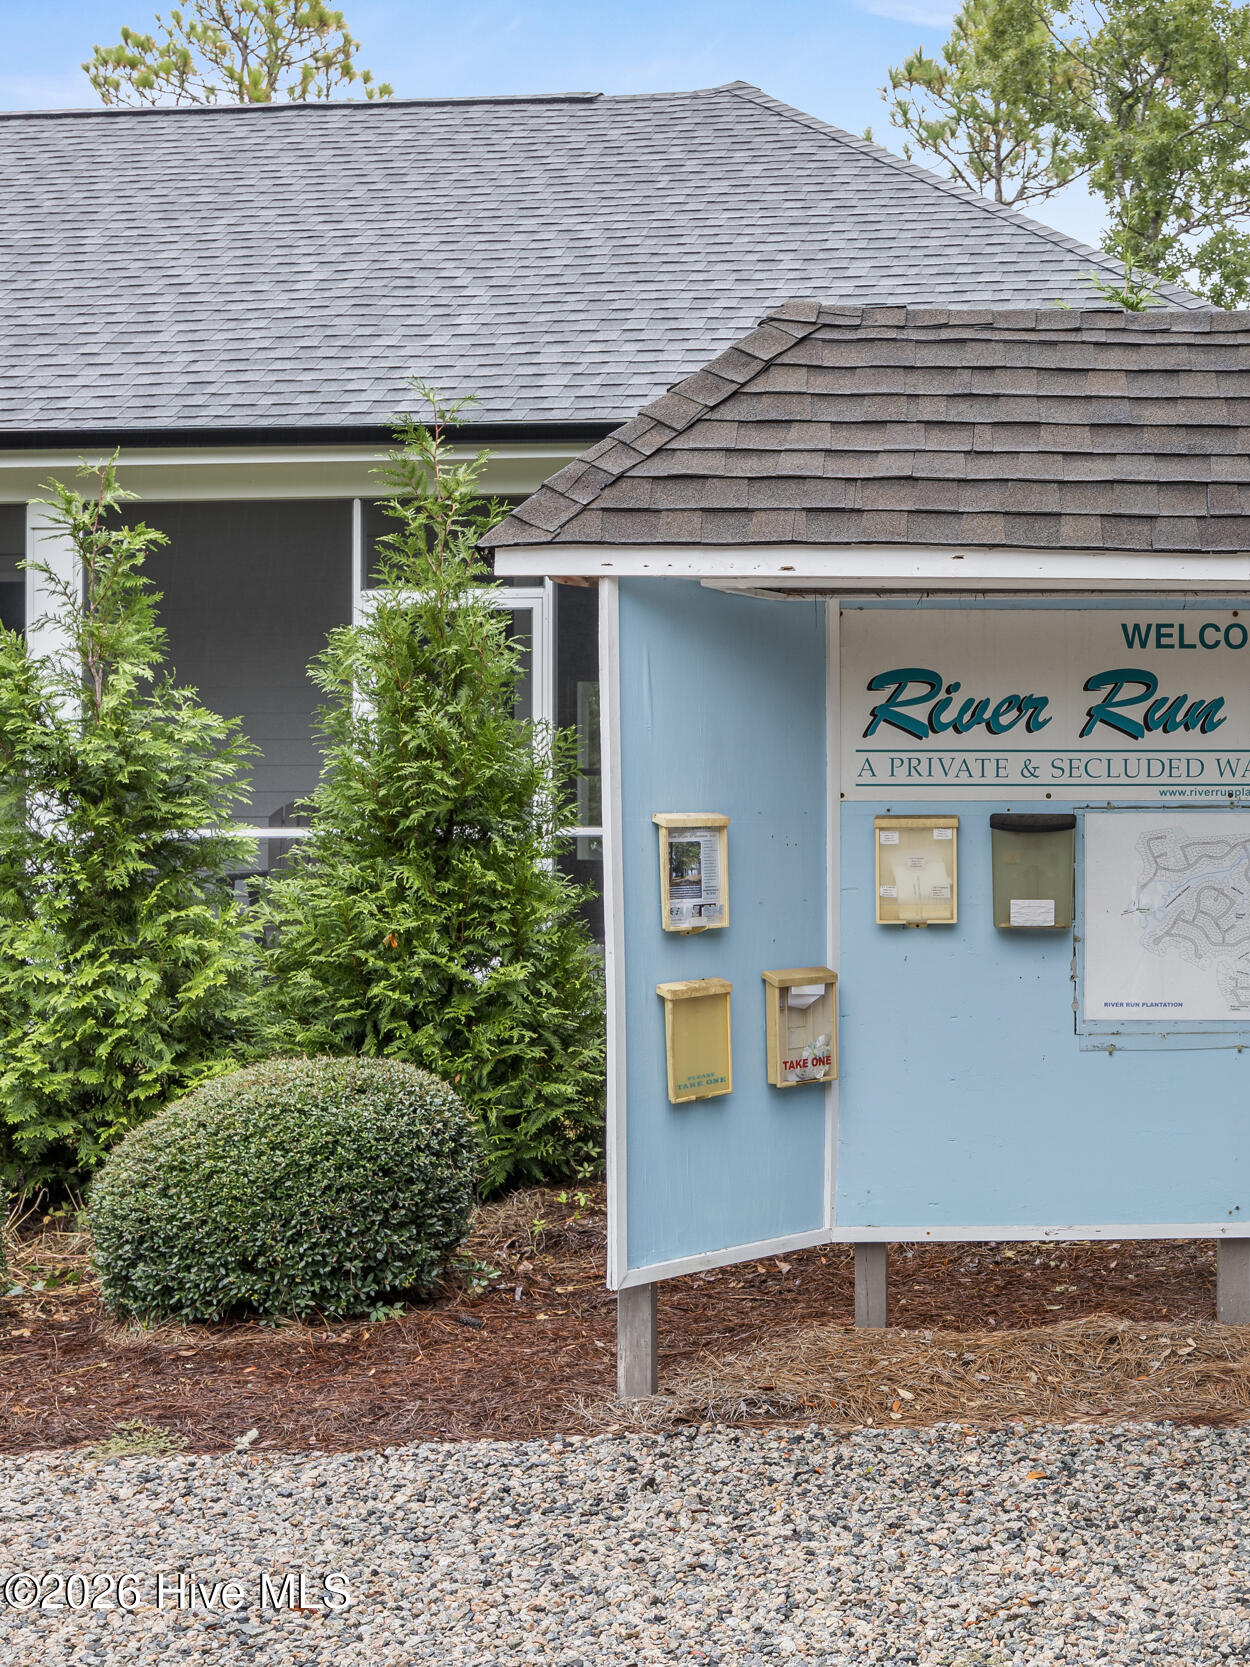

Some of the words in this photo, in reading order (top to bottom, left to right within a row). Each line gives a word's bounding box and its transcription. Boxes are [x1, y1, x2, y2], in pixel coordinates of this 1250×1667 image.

[862, 667, 1052, 740] River
[1079, 668, 1227, 740] Run
[857, 757, 877, 778] A
[888, 757, 1009, 778] PRIVATE
[1020, 757, 1040, 779] &
[1051, 757, 1205, 778] SECLUDED
[782, 1058, 808, 1071] TAKE
[811, 1056, 832, 1067] ONE
